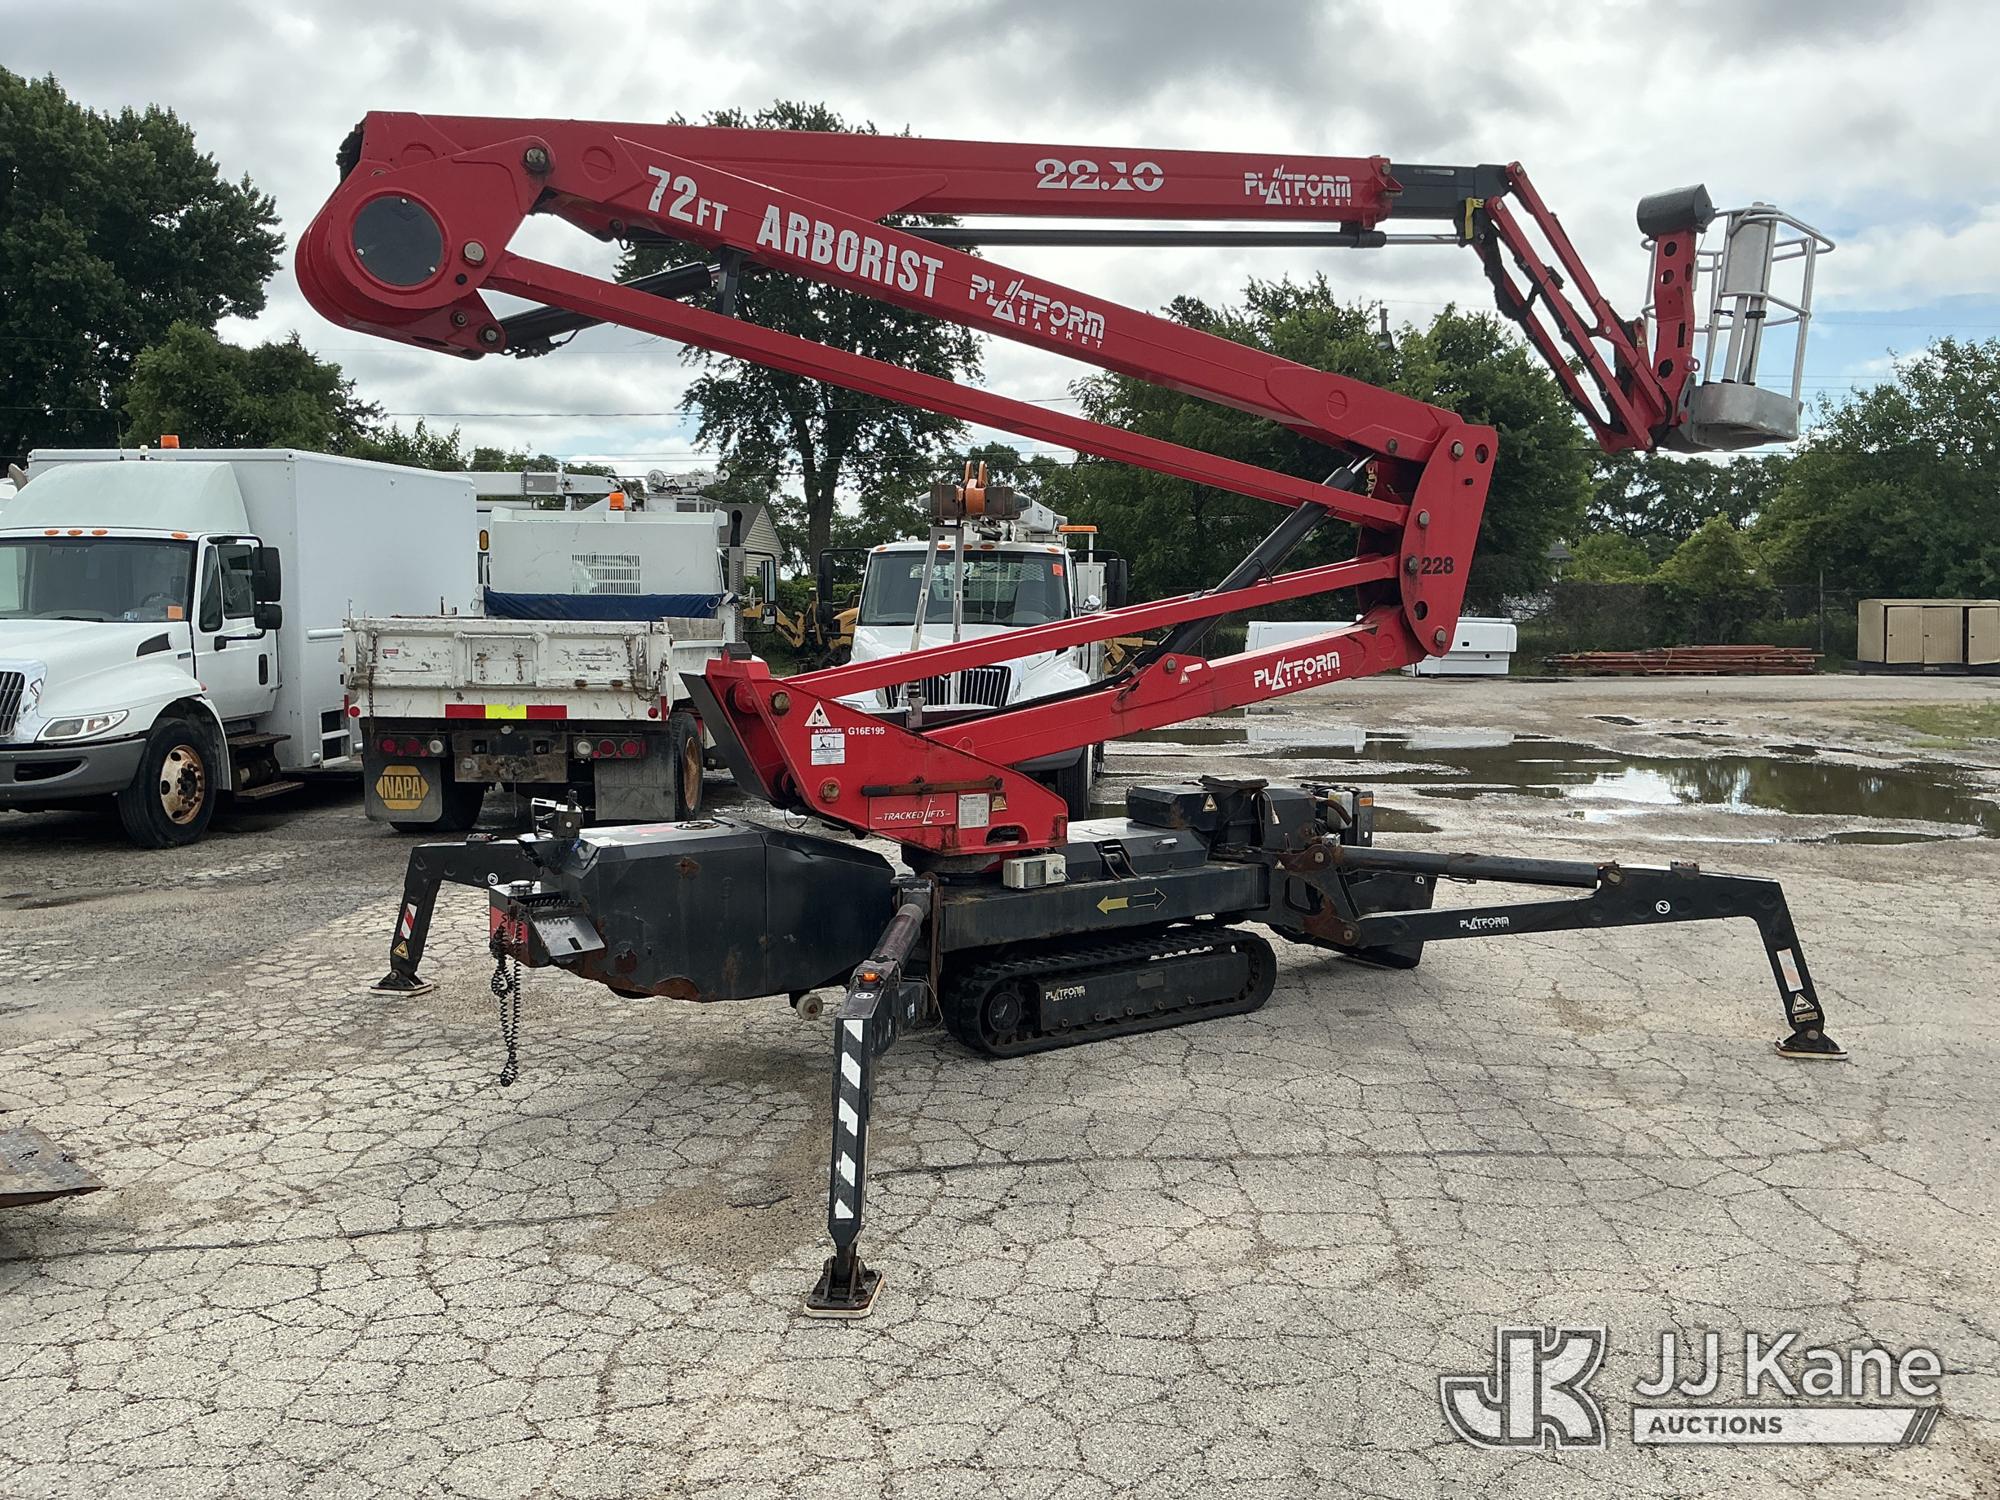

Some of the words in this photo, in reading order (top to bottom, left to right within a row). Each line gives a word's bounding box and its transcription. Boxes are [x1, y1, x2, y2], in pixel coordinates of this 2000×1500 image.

[1035, 158, 1164, 191] 22.10
[1244, 163, 1351, 205] PLATFORM
[1285, 197, 1352, 206] BASKET
[756, 204, 944, 298] ARBORIST
[969, 278, 1105, 340] PLATFORM
[1018, 316, 1103, 349] BASKET
[1421, 556, 1454, 575] 228
[1253, 651, 1341, 691] PLATFORM
[1287, 668, 1341, 687] BASKET
[848, 726, 885, 735] G16E195
[384, 776, 421, 799] NAPA
[1459, 916, 1510, 930] PLATFORM
